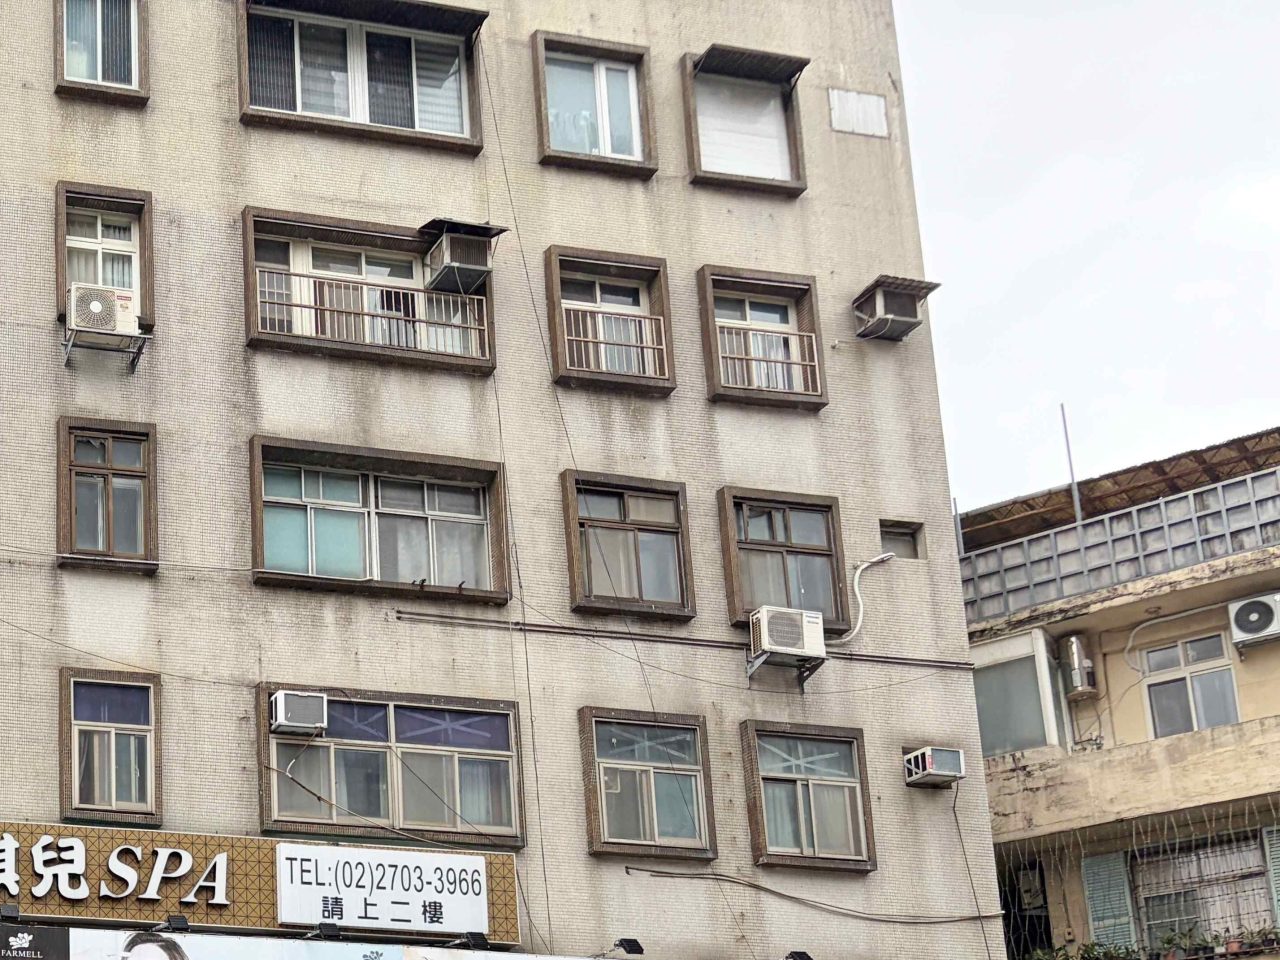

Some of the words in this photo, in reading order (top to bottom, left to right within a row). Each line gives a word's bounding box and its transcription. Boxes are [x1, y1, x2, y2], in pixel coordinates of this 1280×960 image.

[286, 857, 482, 896] TEL:(02)2703-3966
[322, 897, 444, 924] 請上二樓
[1, 949, 43, 959] FARMELL
